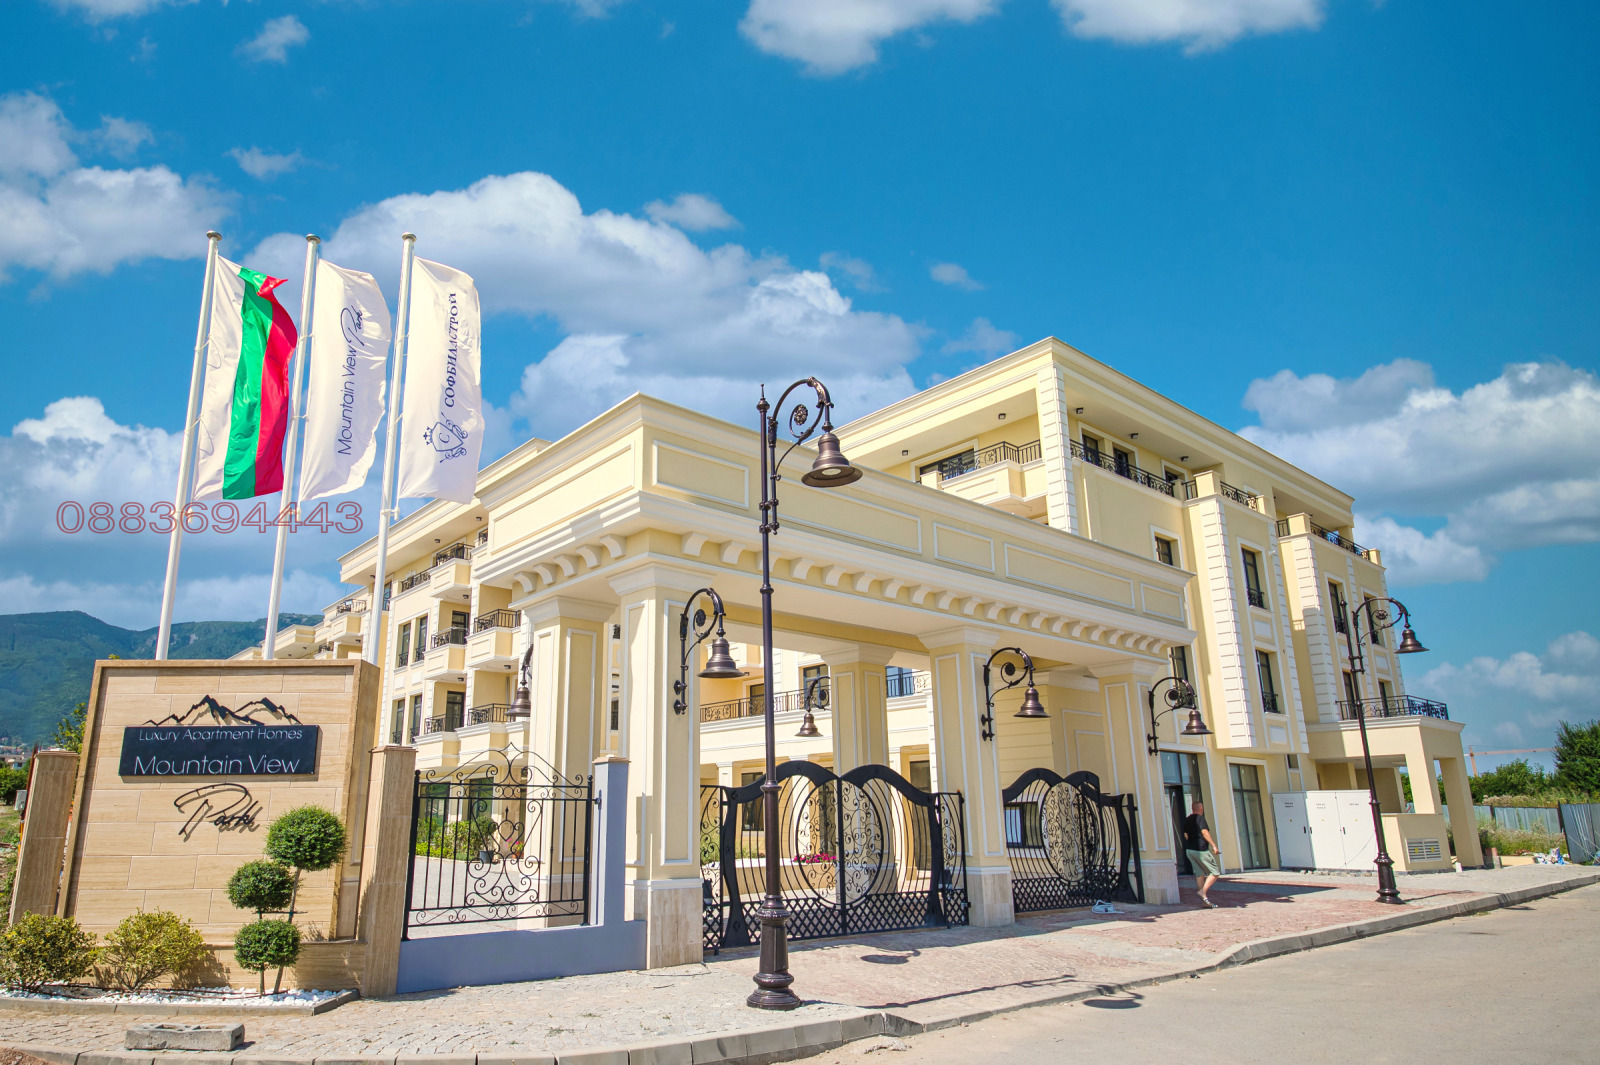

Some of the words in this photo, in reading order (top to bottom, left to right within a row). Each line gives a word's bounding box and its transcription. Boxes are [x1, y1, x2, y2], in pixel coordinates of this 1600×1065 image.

[340, 304, 365, 346] Park
[342, 345, 357, 377] View
[337, 380, 355, 455] Mountain
[139, 729, 180, 743] Luxury
[183, 728, 254, 742] Apartment
[258, 727, 302, 739] Homes
[134, 755, 243, 775] Mountain
[249, 755, 300, 774] View
[173, 783, 258, 835] Park
